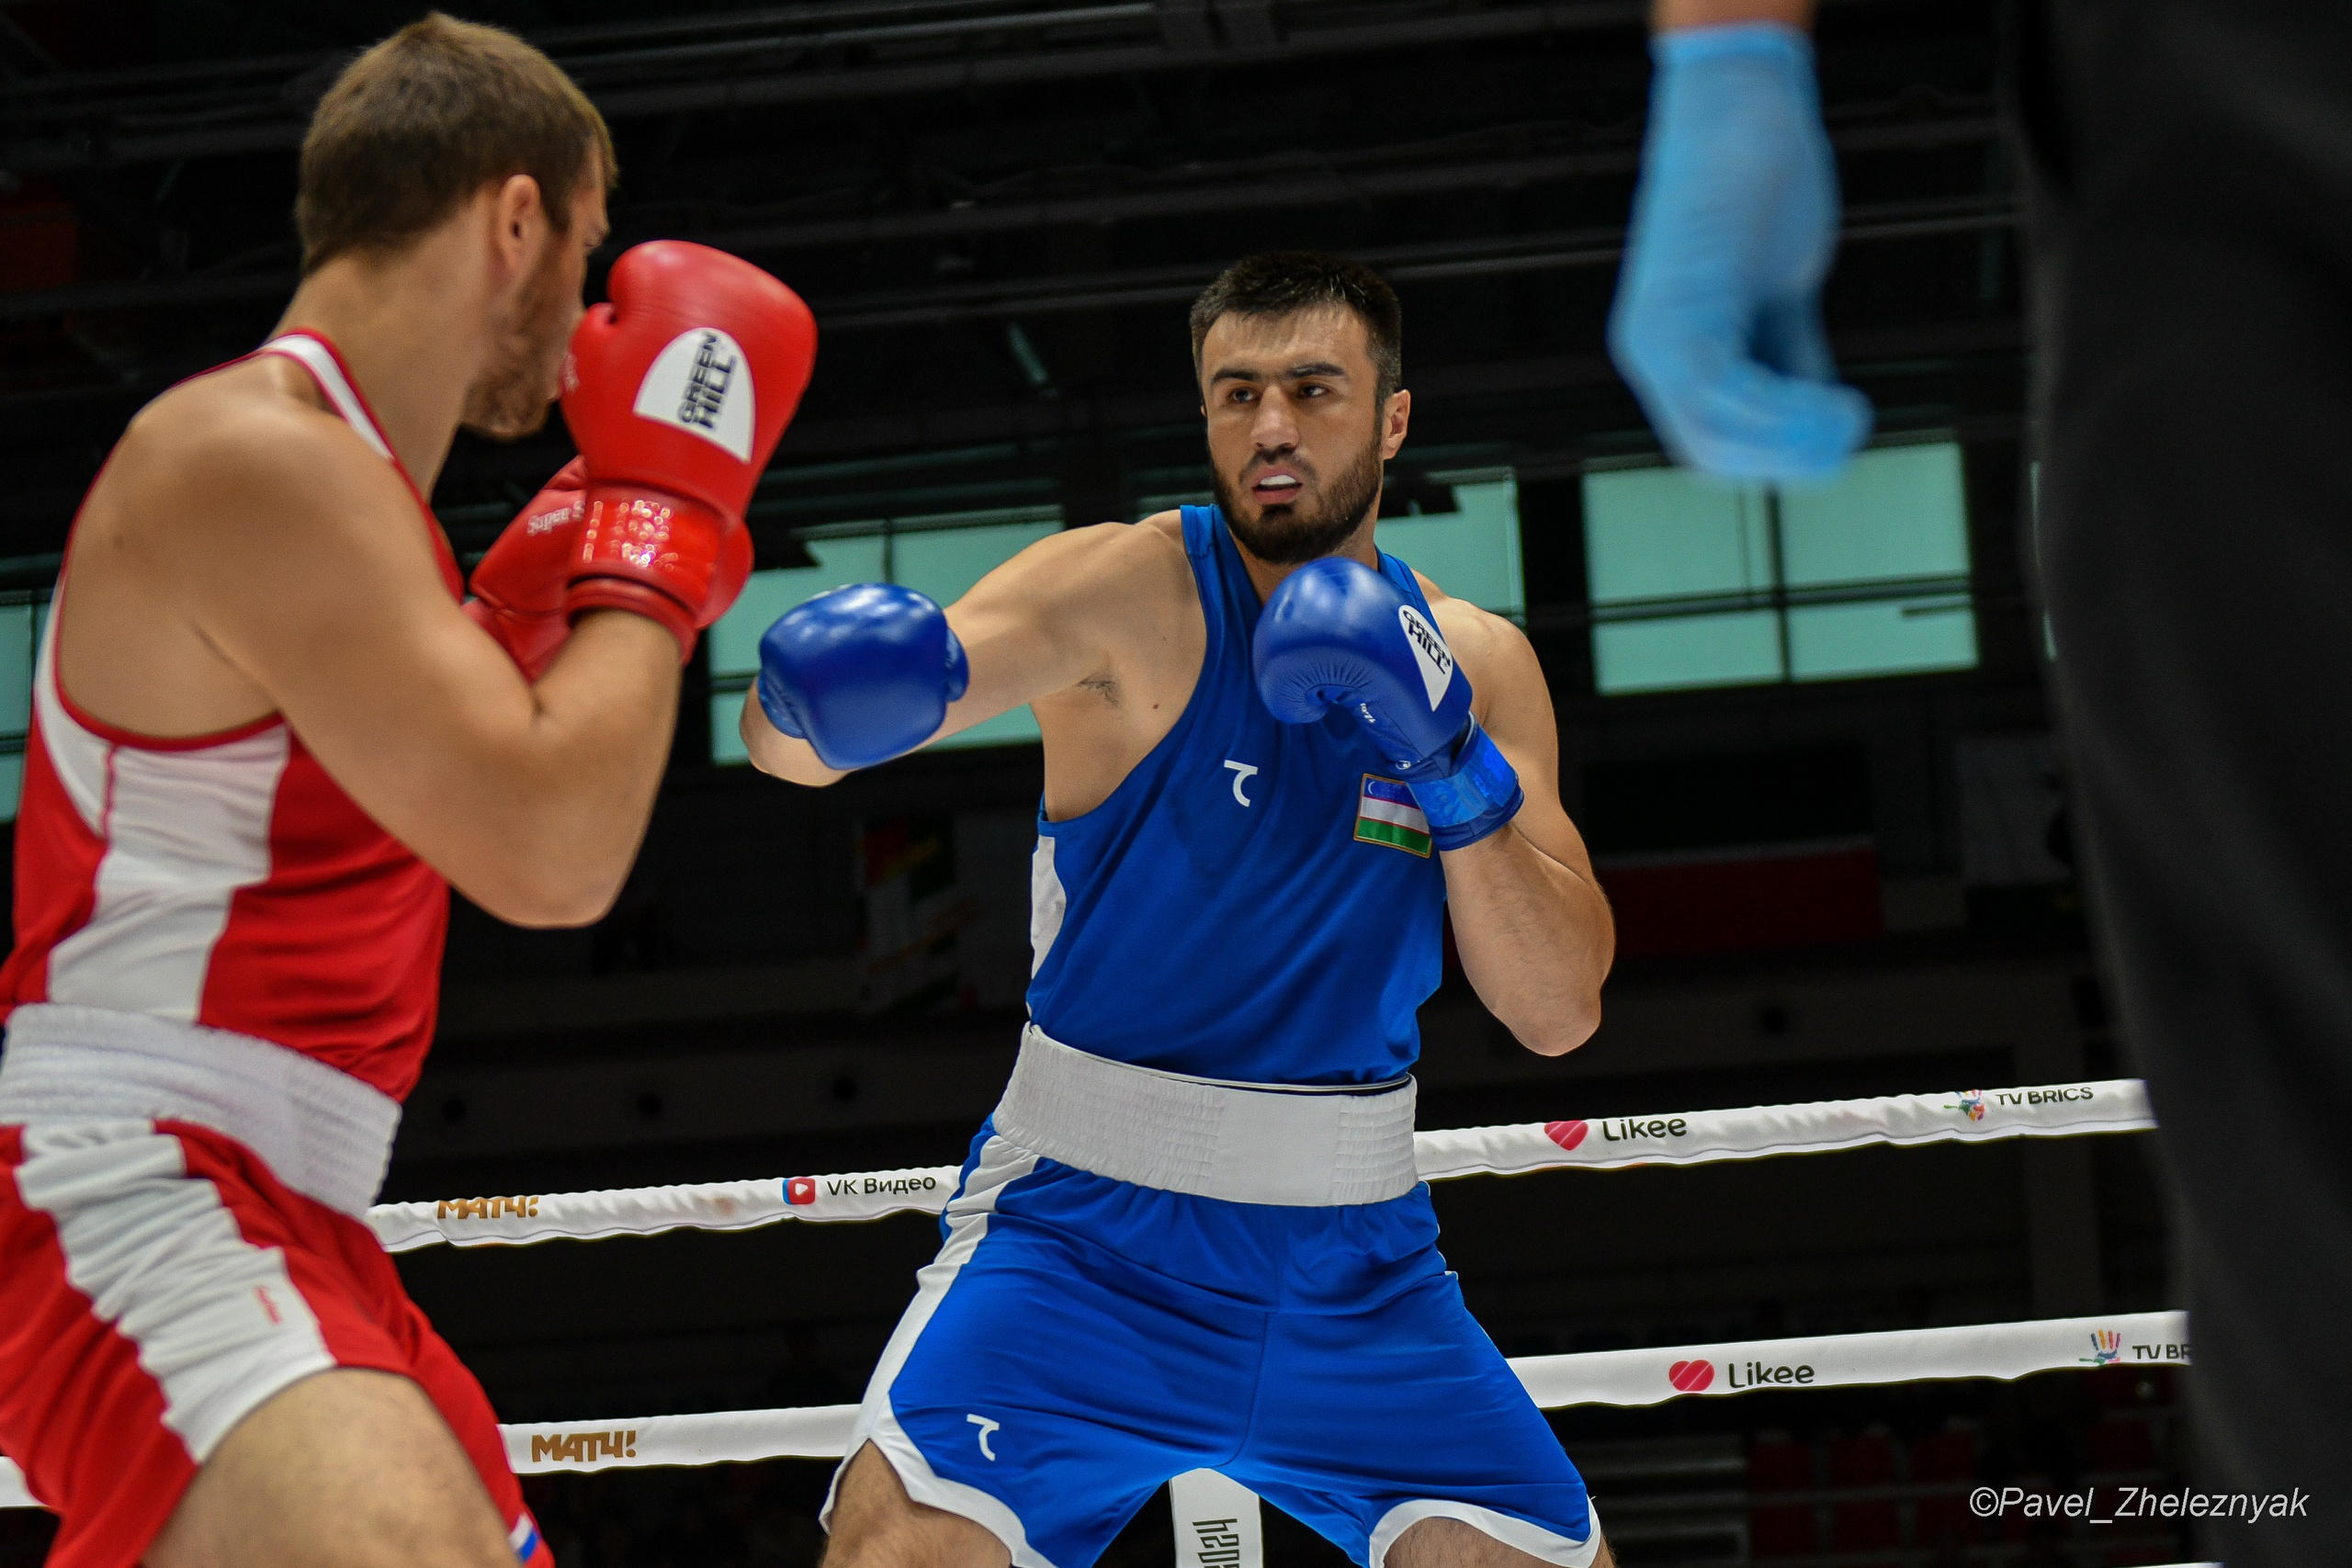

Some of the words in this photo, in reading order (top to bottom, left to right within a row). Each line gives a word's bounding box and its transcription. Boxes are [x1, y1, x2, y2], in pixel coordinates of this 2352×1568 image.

[678, 332, 718, 423] GREEN
[695, 355, 737, 429] HILL
[1402, 609, 1451, 667] GREEN
[1408, 621, 1446, 675] HILL
[1996, 1093, 2022, 1105] TV
[2028, 1087, 2094, 1105] BRICS
[1602, 1118, 1687, 1141] Likee
[827, 1179, 858, 1196] VK
[864, 1177, 936, 1194] Видео
[2132, 1345, 2161, 1359] TV
[1729, 1361, 1815, 1388] Likee
[532, 1430, 636, 1462] МАТЧ!
